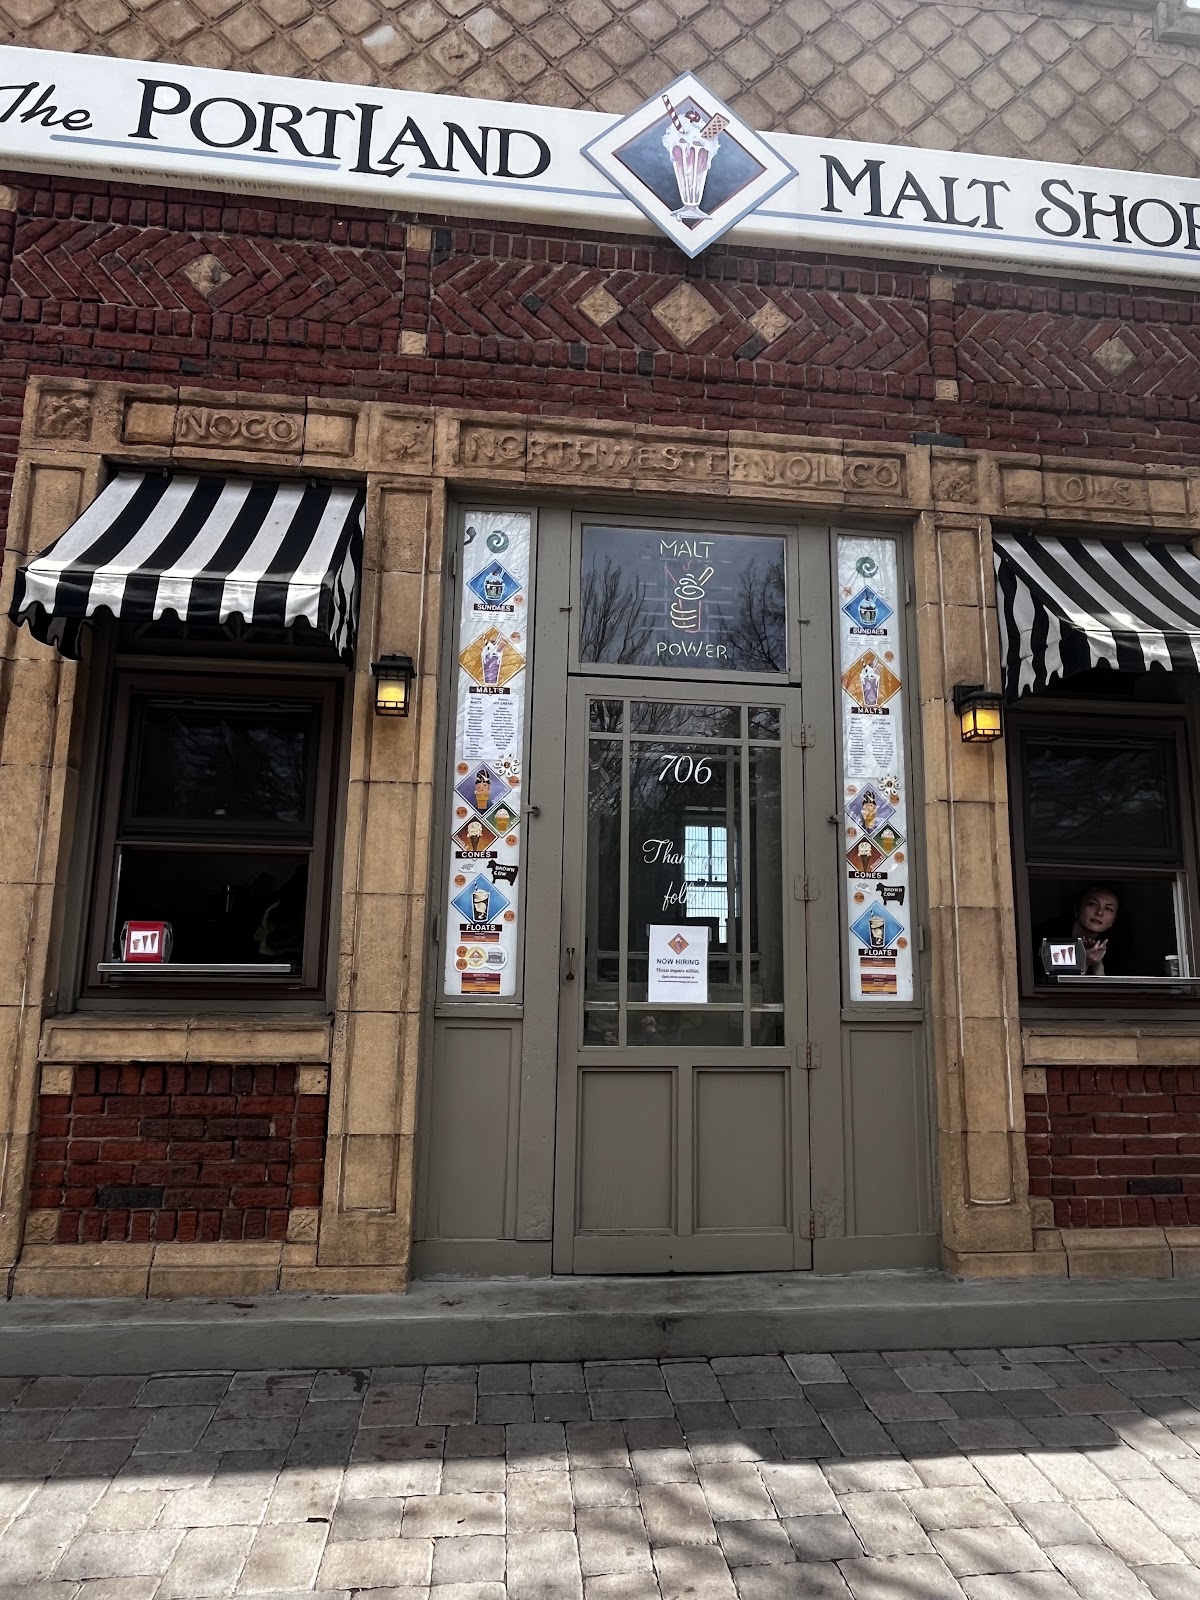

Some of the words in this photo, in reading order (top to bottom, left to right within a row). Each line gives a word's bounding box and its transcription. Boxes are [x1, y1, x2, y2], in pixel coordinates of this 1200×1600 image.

[0, 82, 93, 131] The
[128, 78, 551, 179] PORTLAND
[819, 154, 1010, 230] MALT
[176, 410, 298, 442] NOCO
[849, 462, 899, 487] CO
[660, 539, 715, 559] MALT
[477, 603, 511, 612] SUNDAES
[852, 627, 884, 635] SUNDAES
[656, 641, 728, 660] POWER
[857, 707, 883, 715] MALTS
[658, 754, 712, 784] 706
[854, 871, 882, 879] CONES
[466, 924, 496, 932] FLOATS
[864, 949, 892, 957] FLOATS
